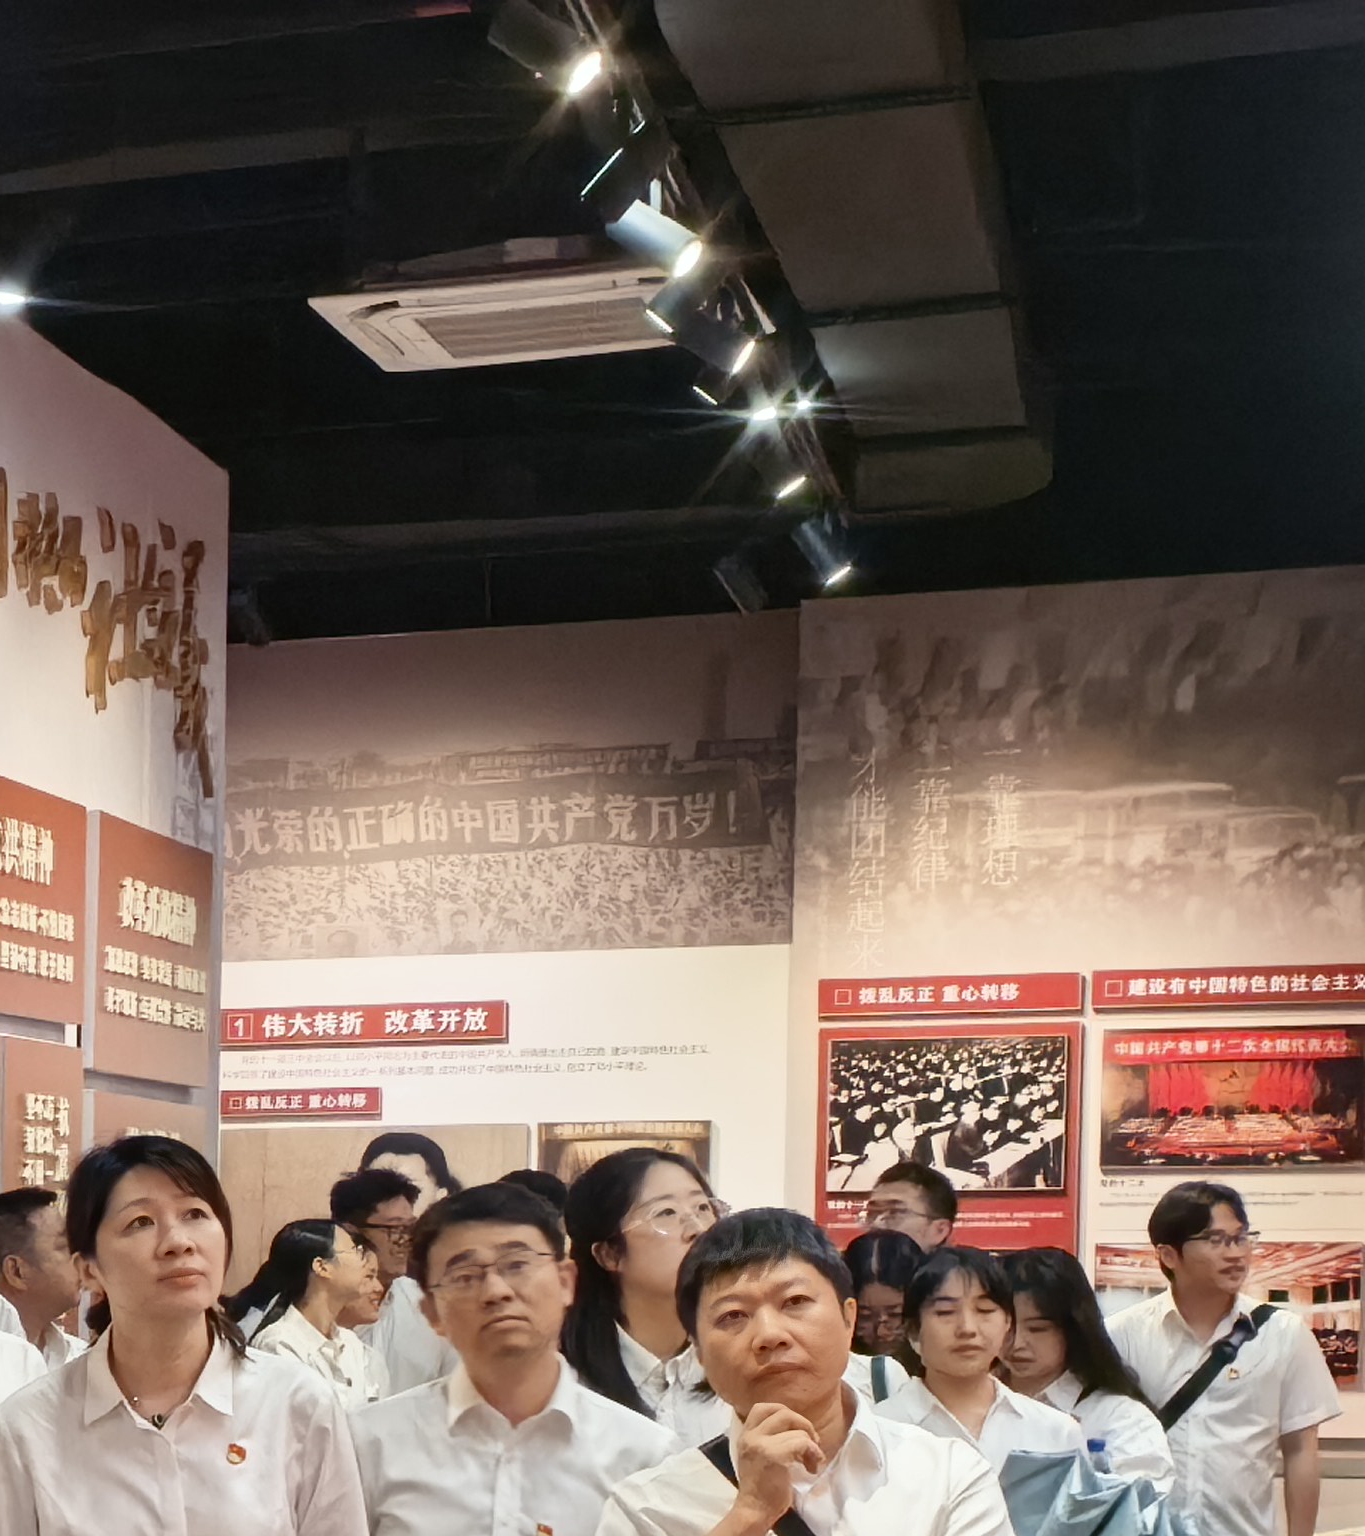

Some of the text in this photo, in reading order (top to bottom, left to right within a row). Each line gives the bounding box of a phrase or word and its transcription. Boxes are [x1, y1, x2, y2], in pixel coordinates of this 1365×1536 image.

[225, 790, 737, 862] 光荣的正确的中国共产党万岁！
[262, 1011, 365, 1038] 伟大转折
[384, 1007, 489, 1035] 改革开放
